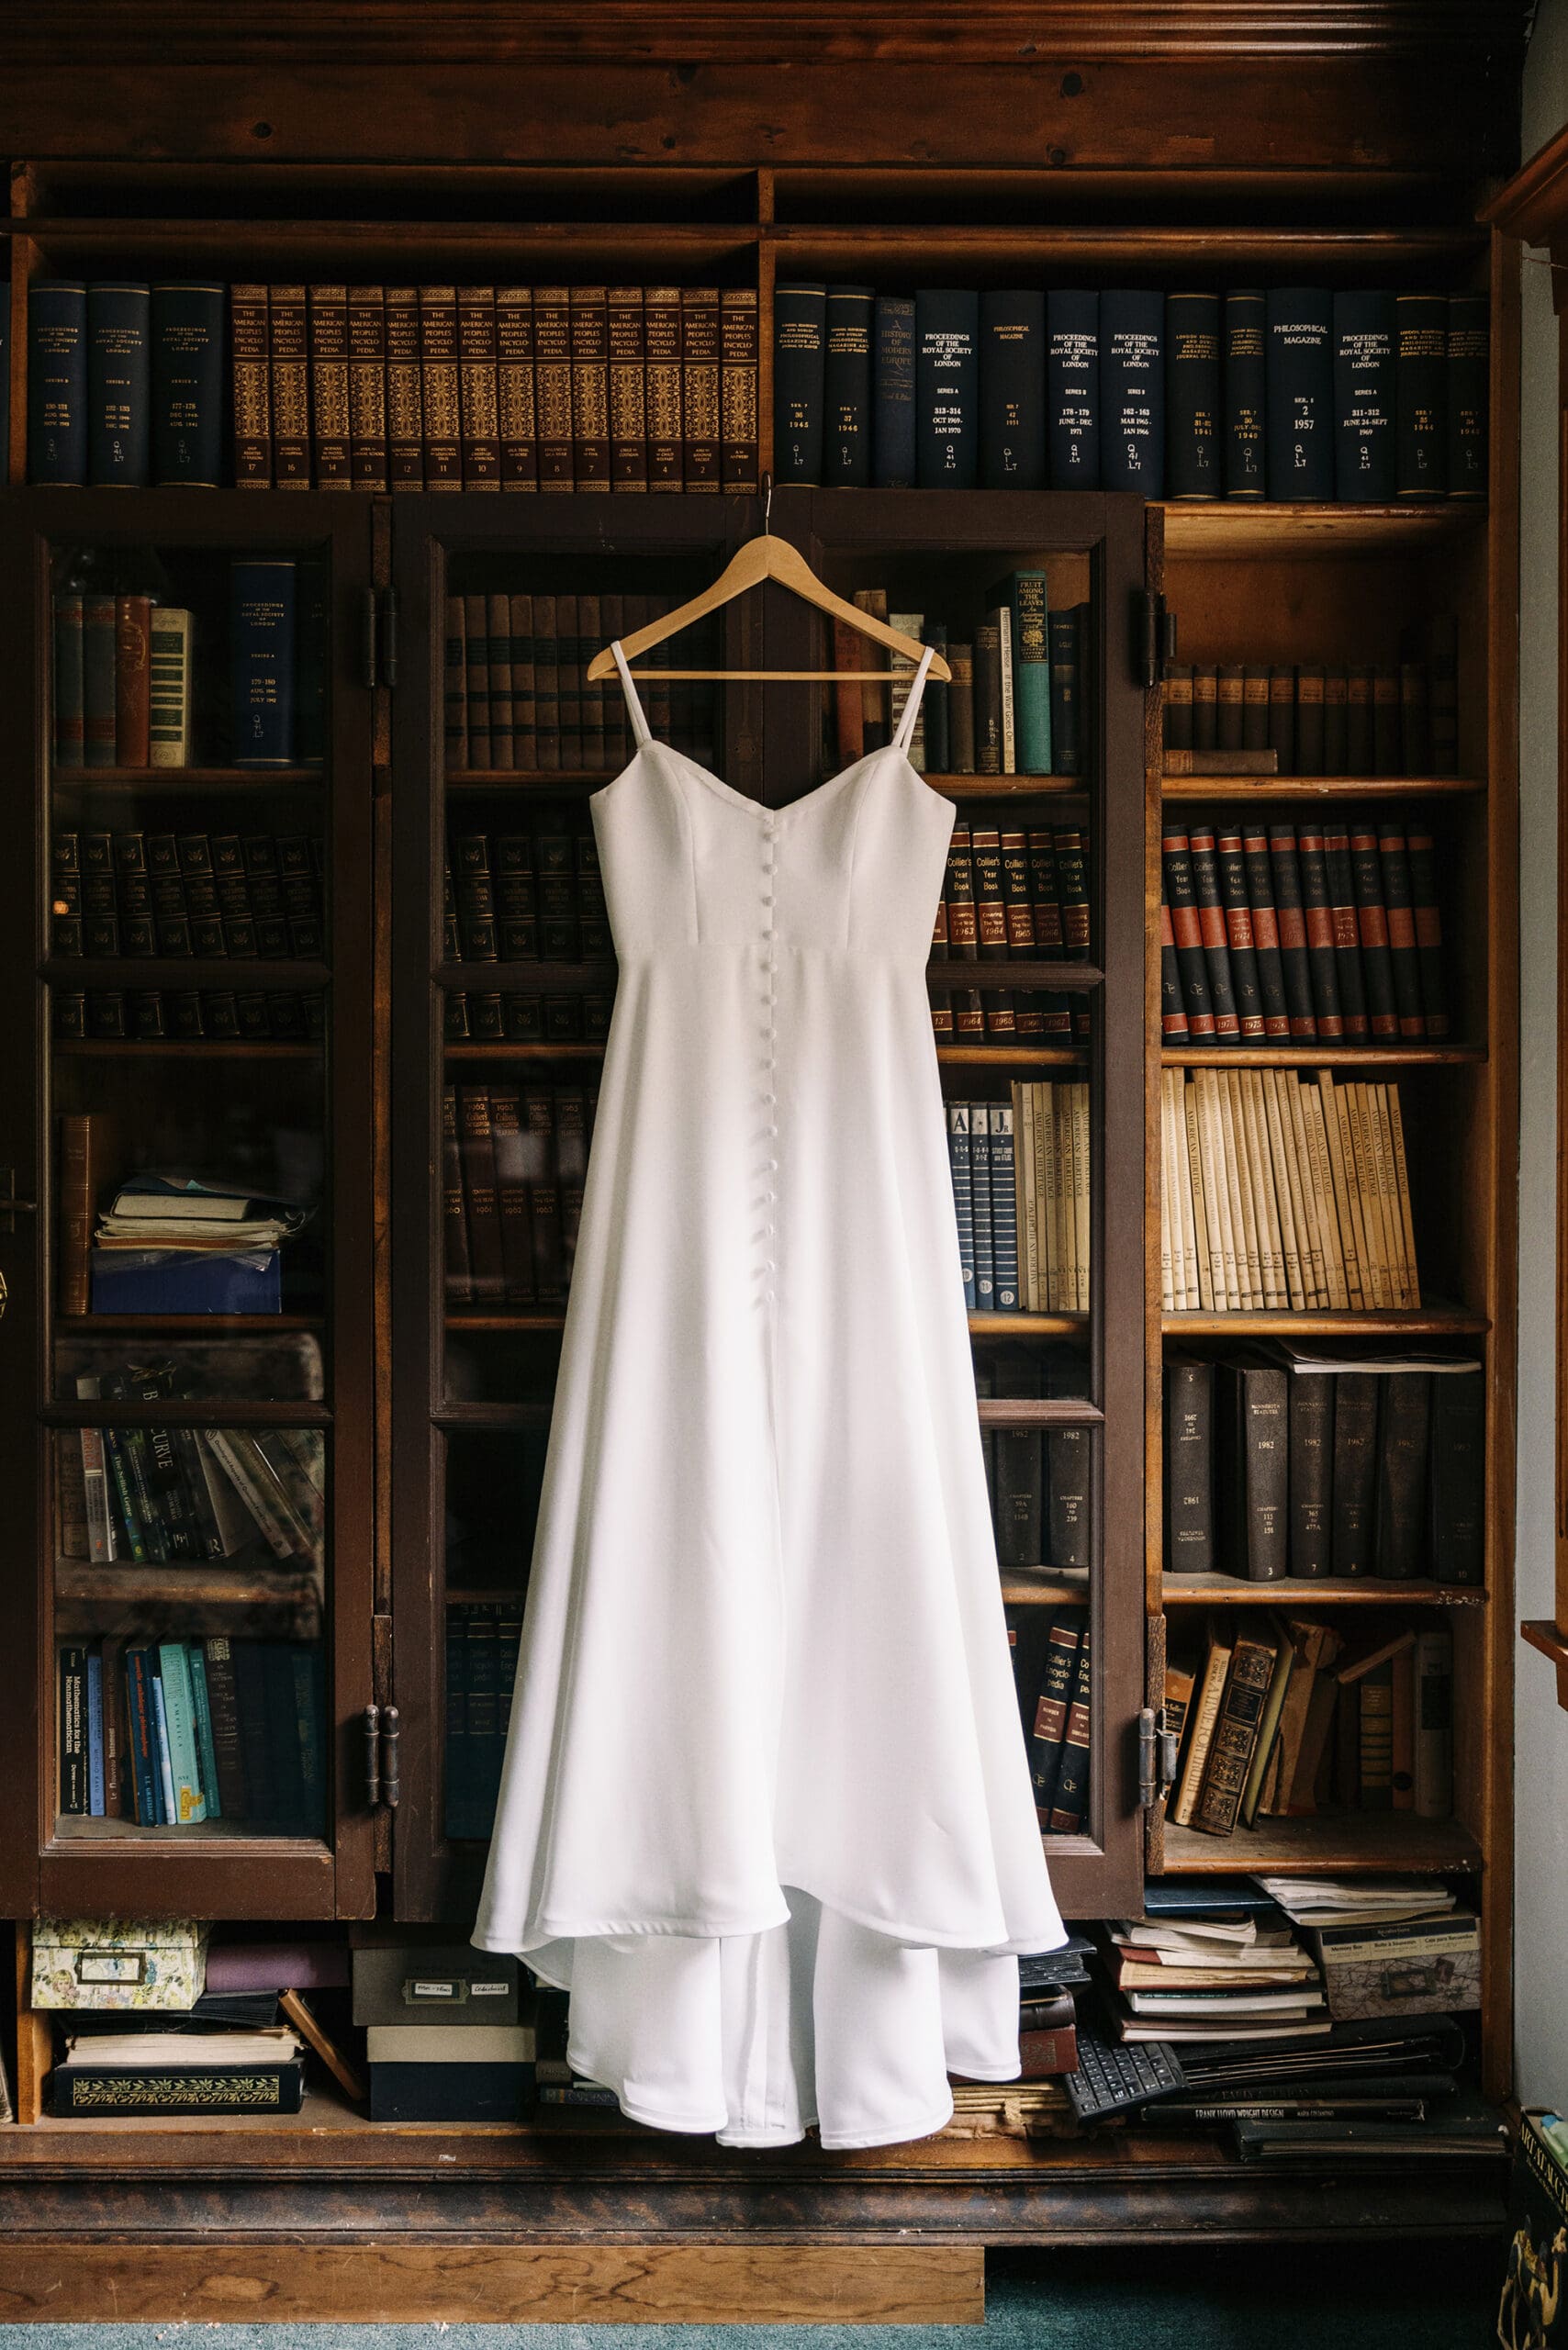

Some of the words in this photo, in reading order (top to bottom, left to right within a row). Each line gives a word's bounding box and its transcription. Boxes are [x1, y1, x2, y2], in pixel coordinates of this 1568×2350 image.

[1273, 324, 1327, 334] PHILOSOPHICAL
[925, 333, 969, 341] PROCEEDINGS
[1053, 334, 1097, 342] PROCEEDINGS
[1114, 334, 1158, 342] PROCEEDINGS
[1342, 334, 1388, 342] PROCEEDINGS
[1134, 348, 1159, 356] SOCIETY
[1303, 406, 1308, 415] 2
[1294, 420, 1315, 430] 1957
[983, 870, 997, 878] Year
[954, 882, 969, 890] Book
[983, 882, 999, 890] Book
[954, 1112, 967, 1131] A
[1188, 1111, 1196, 1152] AMERICAN
[1394, 1110, 1402, 1150] AMERICAN
[1191, 1156, 1201, 1194] HERITAGE
[1397, 1155, 1406, 1193] HERITAGE
[114, 1454, 123, 1469] The
[118, 1471, 128, 1496] Selfish
[124, 1497, 132, 1516] Gene
[1268, 1567, 1273, 1575] 3
[1195, 2109, 1216, 2119] FRANK
[1217, 2109, 1236, 2118] LLOYD
[1237, 2109, 1260, 2119] WRIGHT
[1261, 2109, 1284, 2118] DESIGN
